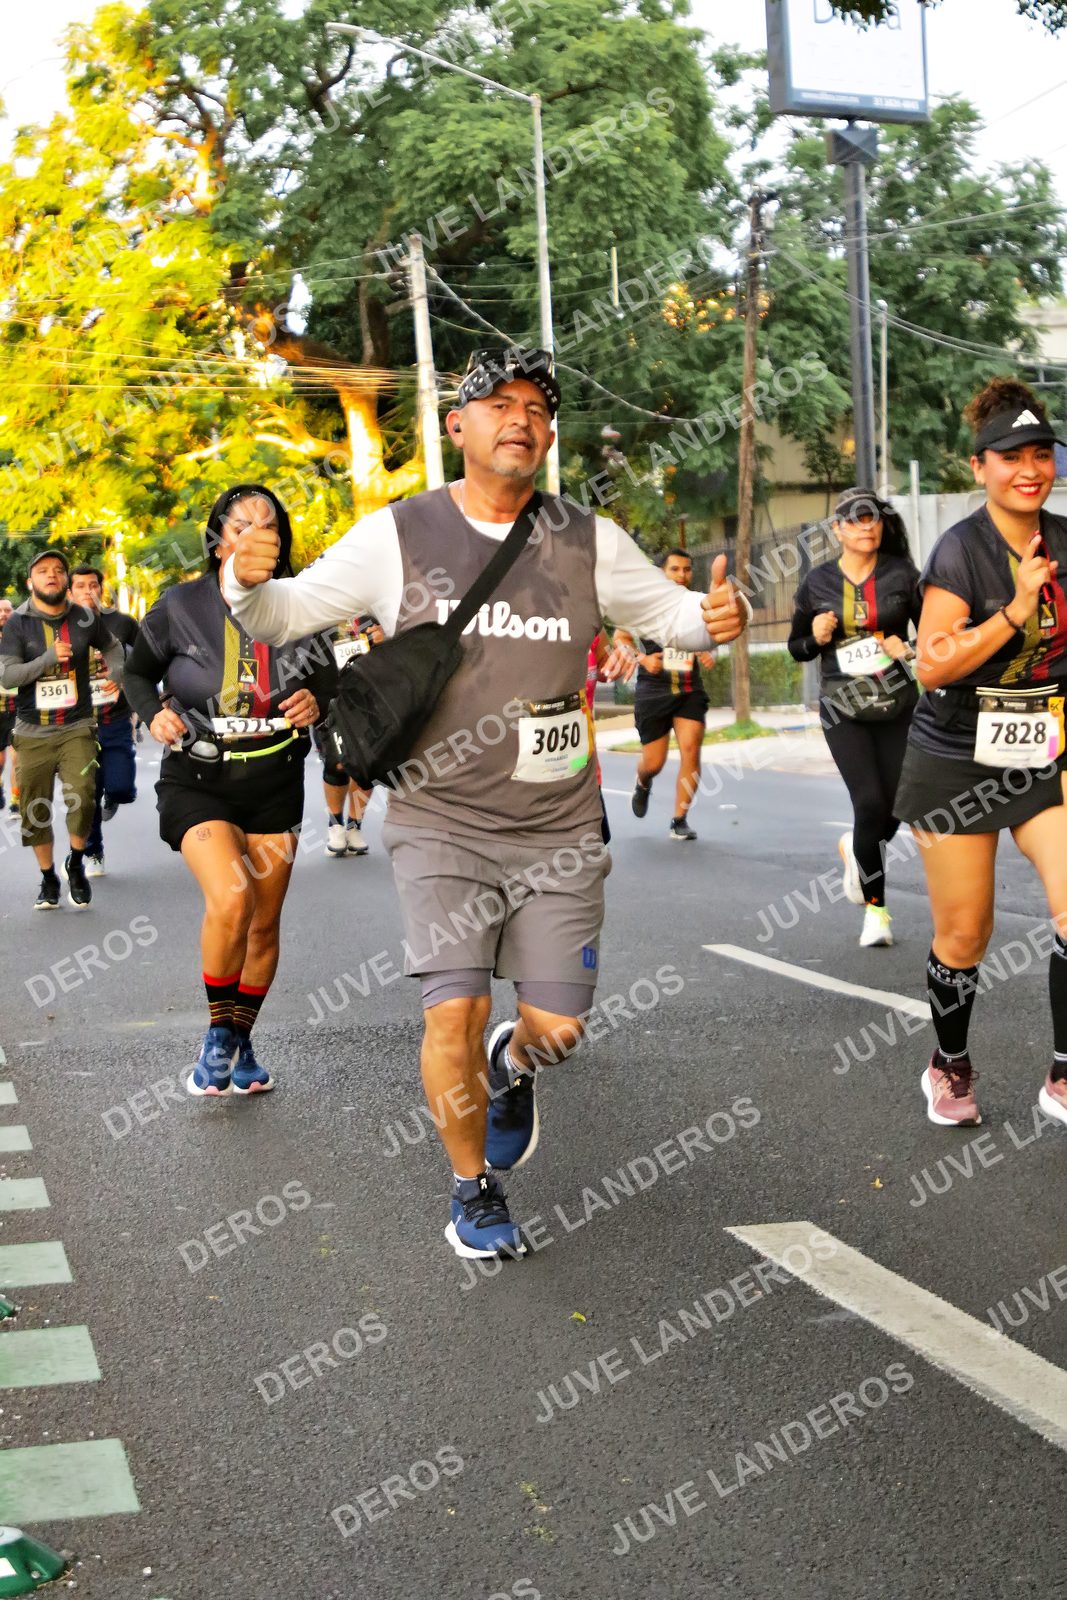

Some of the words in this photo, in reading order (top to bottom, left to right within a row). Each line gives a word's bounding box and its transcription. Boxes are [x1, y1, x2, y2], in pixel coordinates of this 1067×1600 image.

[845, 641, 881, 664] 2432
[41, 684, 69, 697] 5361
[532, 721, 580, 755] 3050
[990, 721, 1047, 744] 7828
